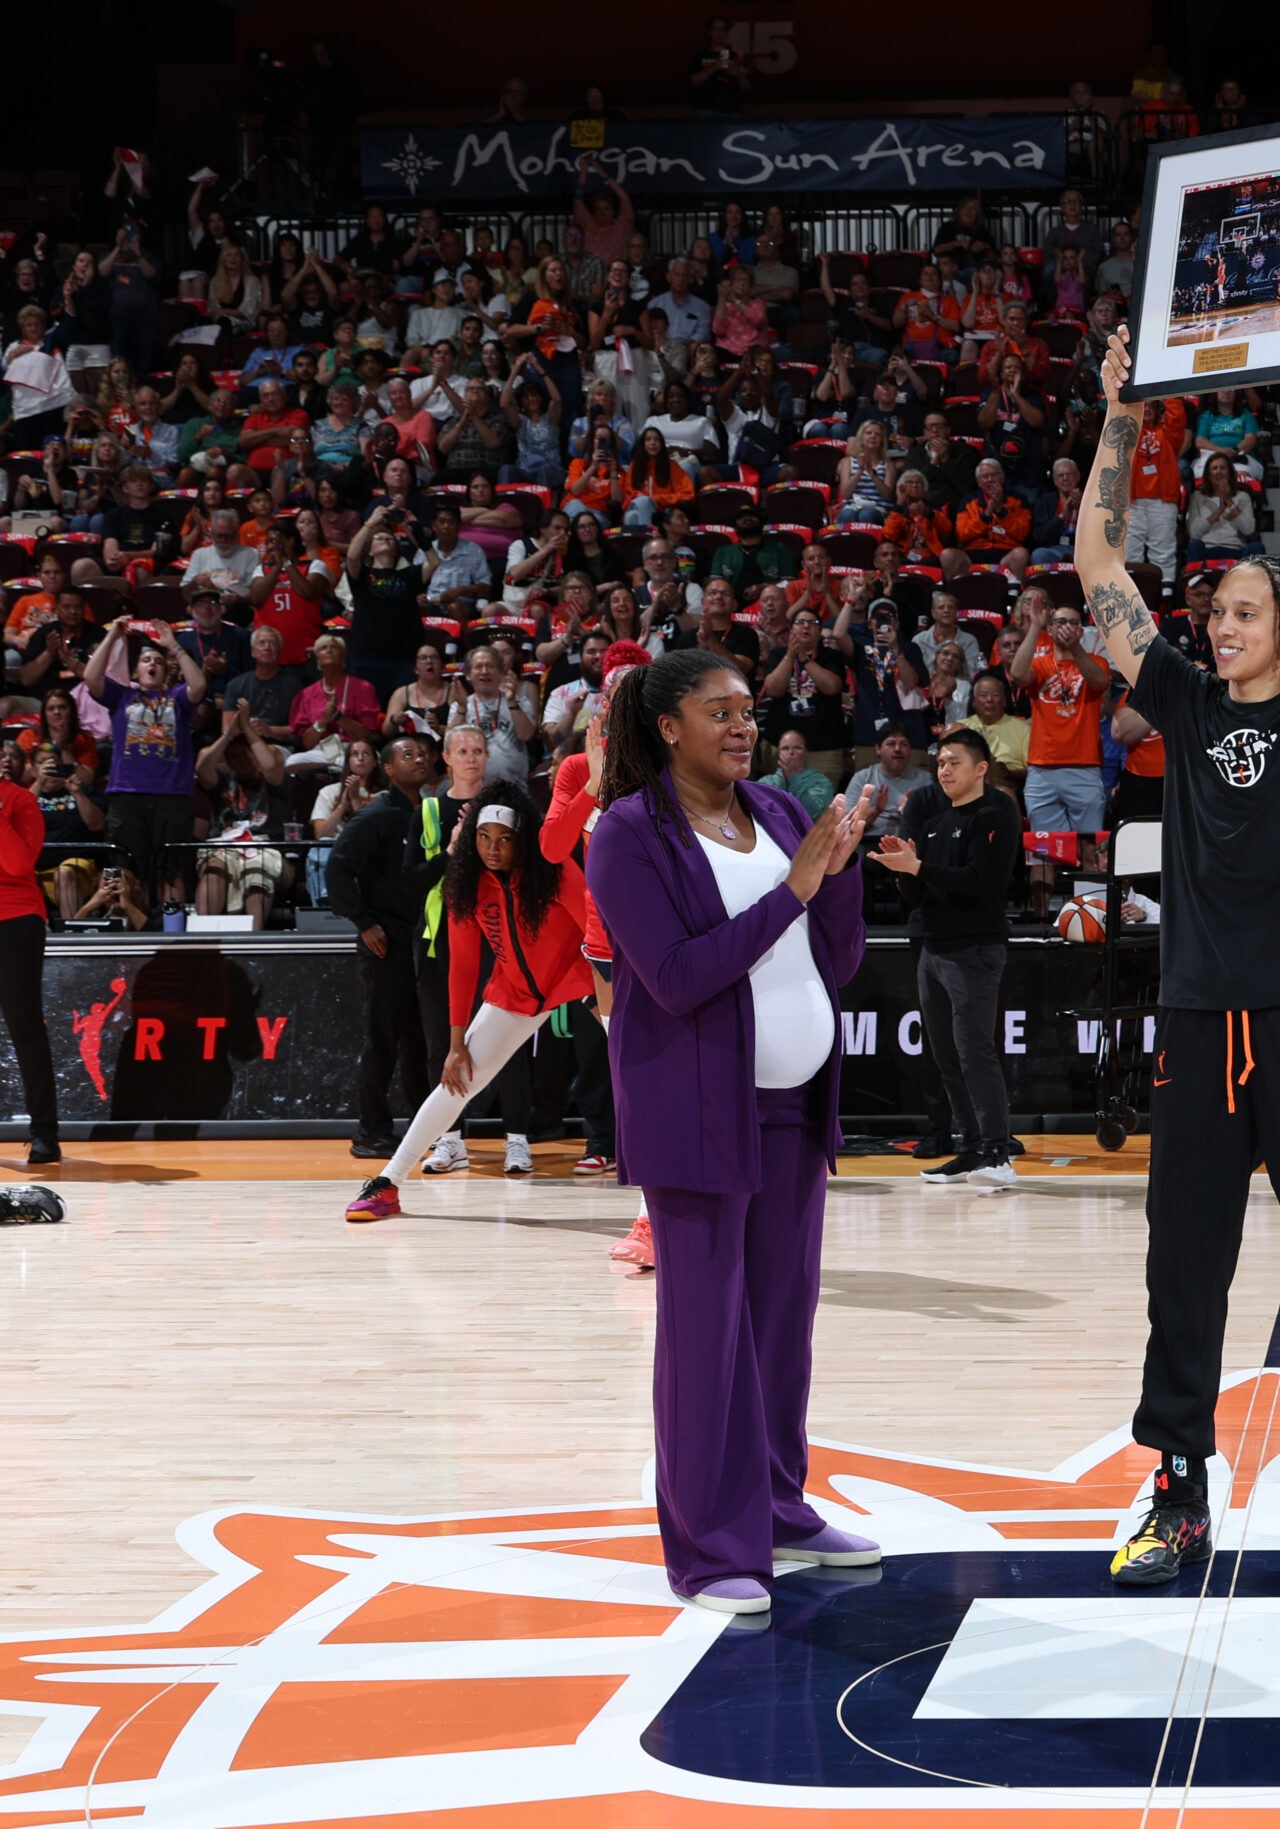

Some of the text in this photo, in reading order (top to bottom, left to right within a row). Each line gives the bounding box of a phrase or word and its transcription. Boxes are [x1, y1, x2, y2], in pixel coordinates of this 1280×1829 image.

[718, 130, 839, 185] Sun
[851, 123, 1046, 186] Arena
[273, 592, 292, 612] 51
[840, 1010, 1027, 1055] MOE
